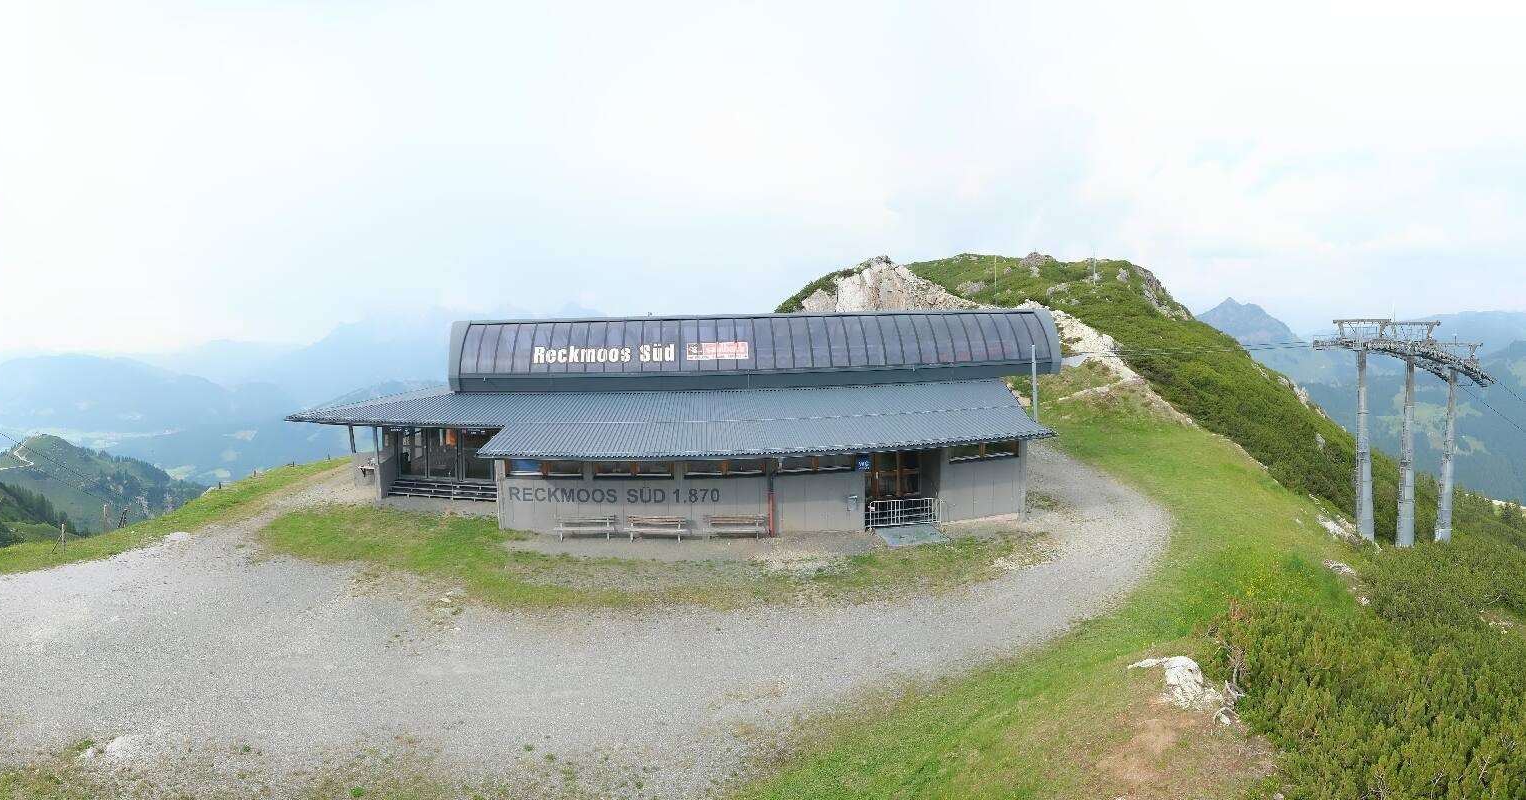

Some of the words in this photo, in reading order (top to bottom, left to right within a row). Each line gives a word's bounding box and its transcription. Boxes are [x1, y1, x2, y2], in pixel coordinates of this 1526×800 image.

[533, 345, 631, 364] Reckmoos
[639, 343, 675, 362] Süd
[508, 486, 618, 504] RECKMOOS
[626, 486, 666, 504] SÜD
[672, 487, 720, 504] 1.870
